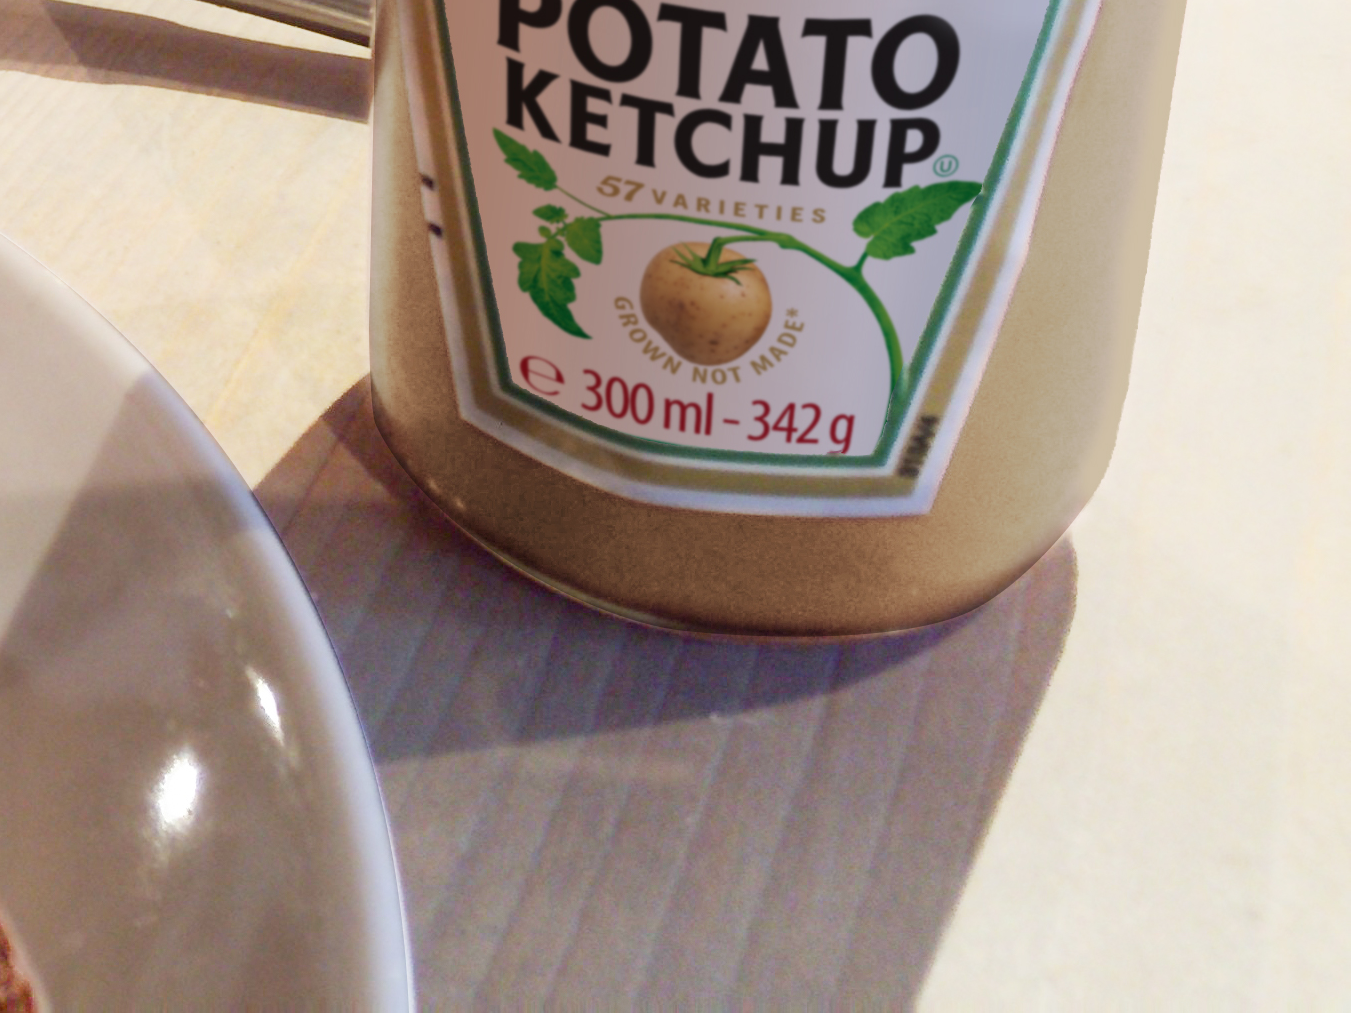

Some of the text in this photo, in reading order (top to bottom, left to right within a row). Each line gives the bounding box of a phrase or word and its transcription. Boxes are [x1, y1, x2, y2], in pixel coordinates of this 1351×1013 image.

[504, 55, 942, 188] KETCHUP
[596, 175, 826, 224] 57 VARIETIES
[613, 296, 683, 375] GROWN
[691, 366, 742, 385] NOT
[581, 368, 655, 425] 300
[663, 392, 714, 436] ml
[746, 399, 822, 445] 342
[826, 413, 855, 455] g
